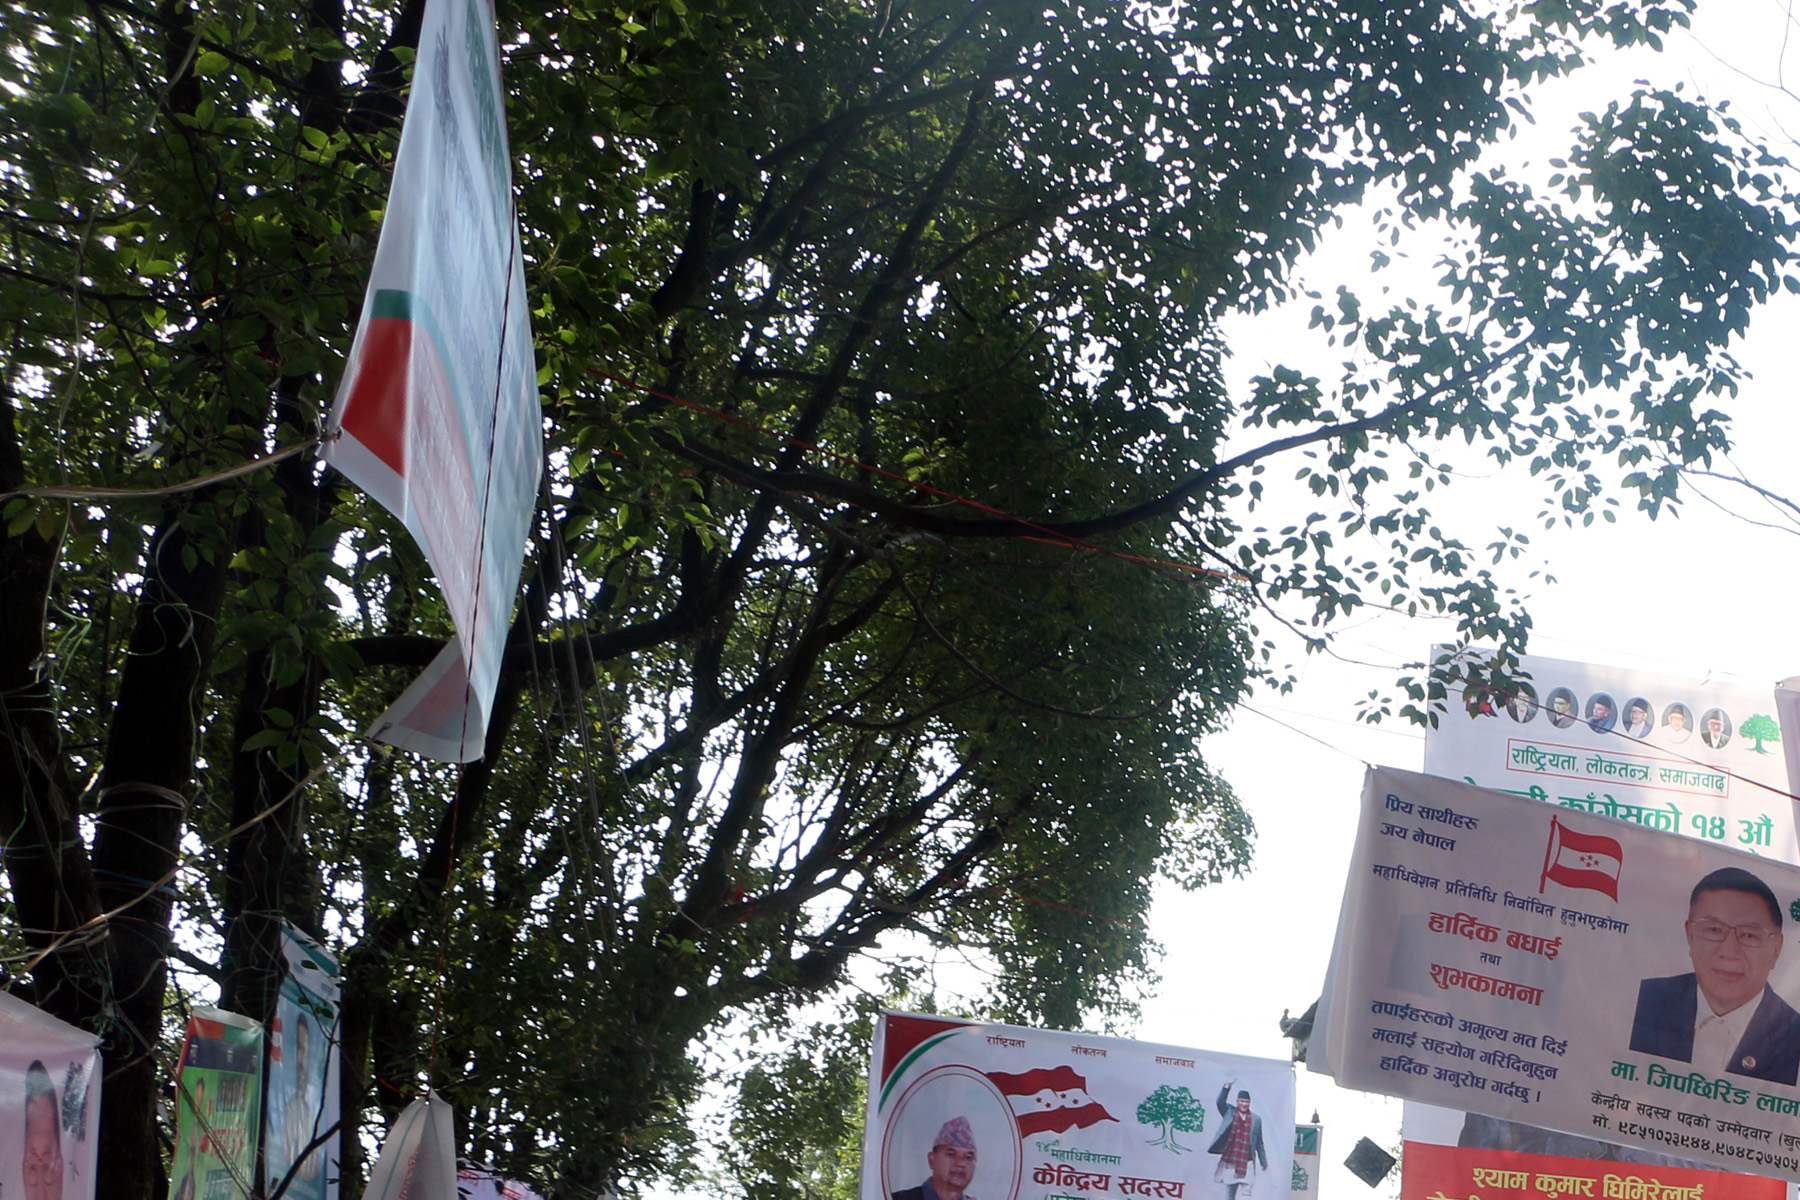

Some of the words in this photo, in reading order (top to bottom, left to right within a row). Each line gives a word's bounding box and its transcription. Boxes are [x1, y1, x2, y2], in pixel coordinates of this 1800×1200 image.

[1385, 793, 1412, 814] प्रिय
[1380, 823, 1407, 838] जय
[1413, 829, 1456, 851] नेपाल
[1692, 814, 1725, 839] १४
[1373, 863, 1440, 889] महाधिवेशन
[1428, 912, 1501, 943] हार्दिक
[1506, 930, 1562, 960] बधाई
[1479, 952, 1502, 965] तथा
[1430, 963, 1544, 1006] शुभकामना
[1372, 1027, 1416, 1049] मलाई
[1421, 1037, 1475, 1061] सहयोग
[1513, 1034, 1536, 1048] मत
[1118, 1176, 1185, 1199] सदस्य
[1473, 1167, 1530, 1190] श्याम
[1535, 1175, 1596, 1199] कुमार
